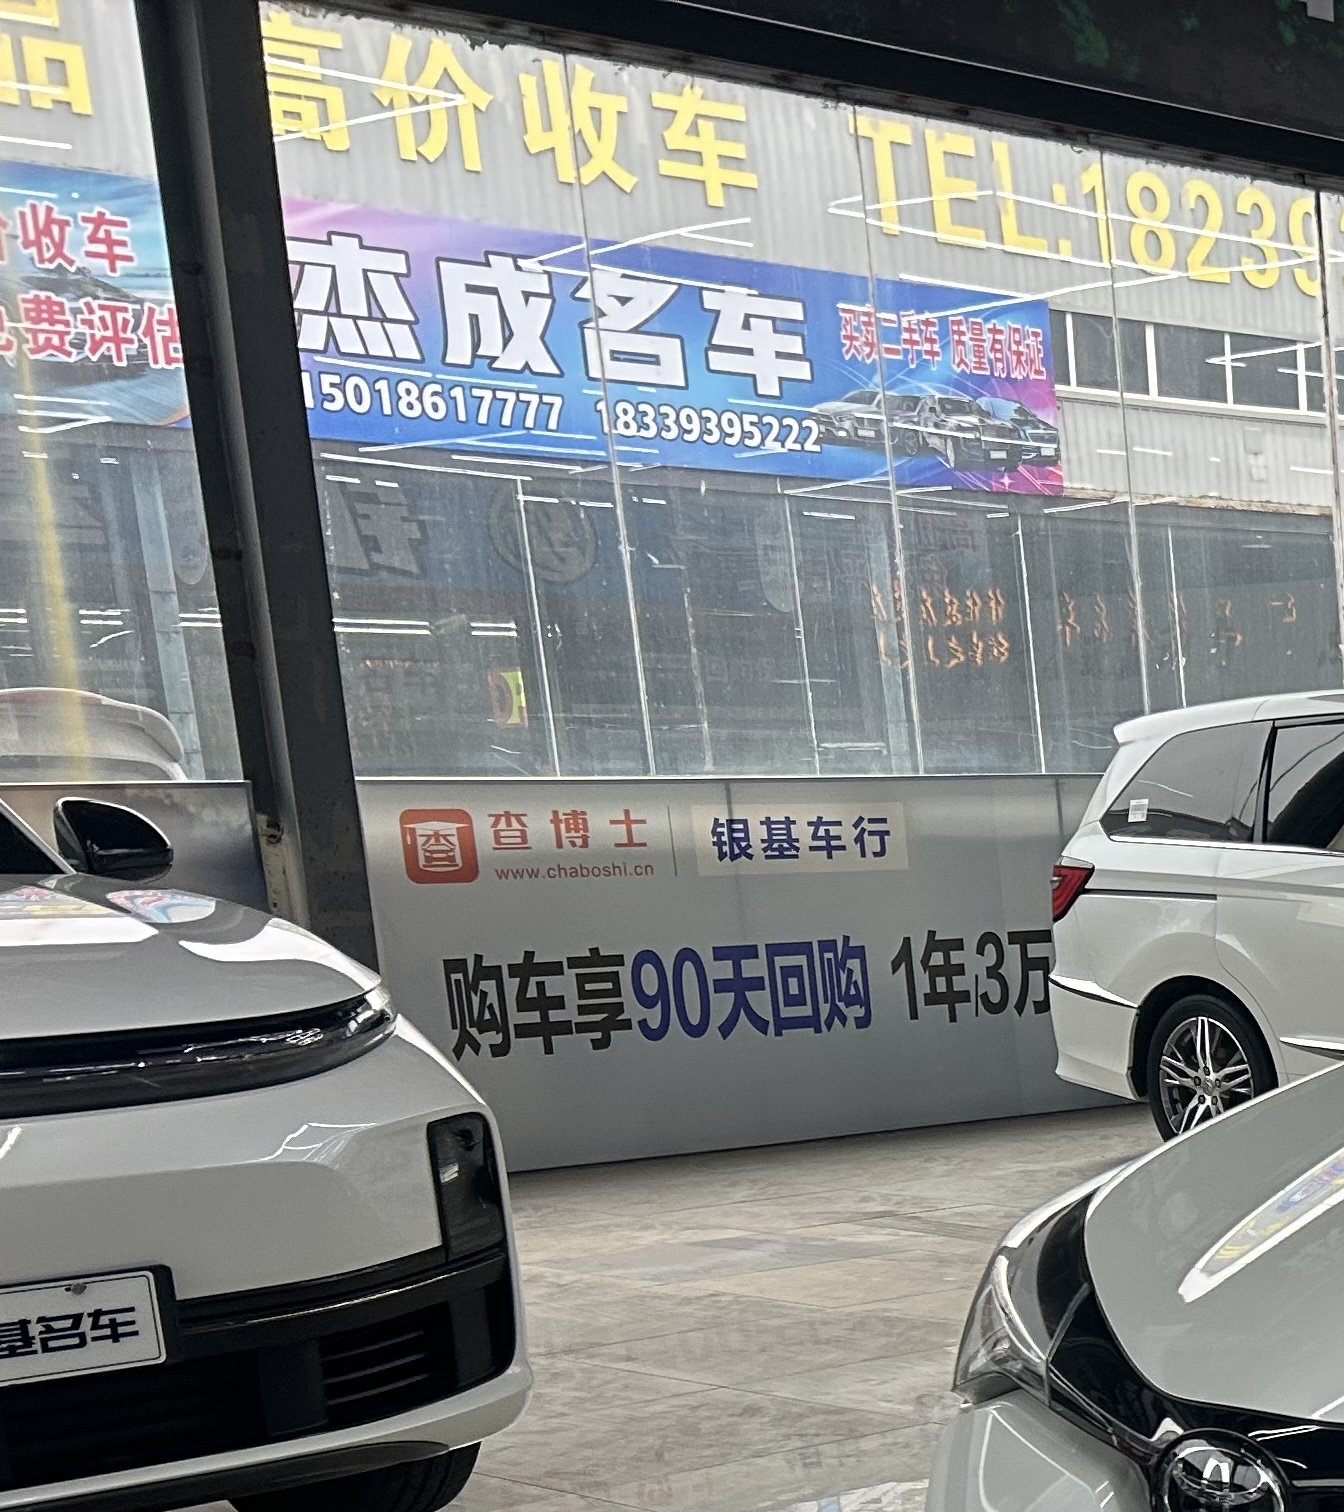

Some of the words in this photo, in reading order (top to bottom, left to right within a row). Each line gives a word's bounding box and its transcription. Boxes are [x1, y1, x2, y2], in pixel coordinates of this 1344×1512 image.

[259, 10, 759, 208] 高价收车
[0, 200, 135, 276] 收车
[0, 290, 185, 369] 费评估
[287, 231, 815, 398] 杰成名车
[838, 305, 942, 370] 买卖二手车
[950, 316, 1047, 380] 质量有保证
[302, 370, 564, 432] 15018617777
[596, 398, 822, 454] 18339395222
[487, 807, 648, 853] 查博士
[711, 814, 893, 864] 银基车行
[494, 860, 655, 882] www.chaboshi.cn
[442, 934, 873, 1063] 购车享90天回购
